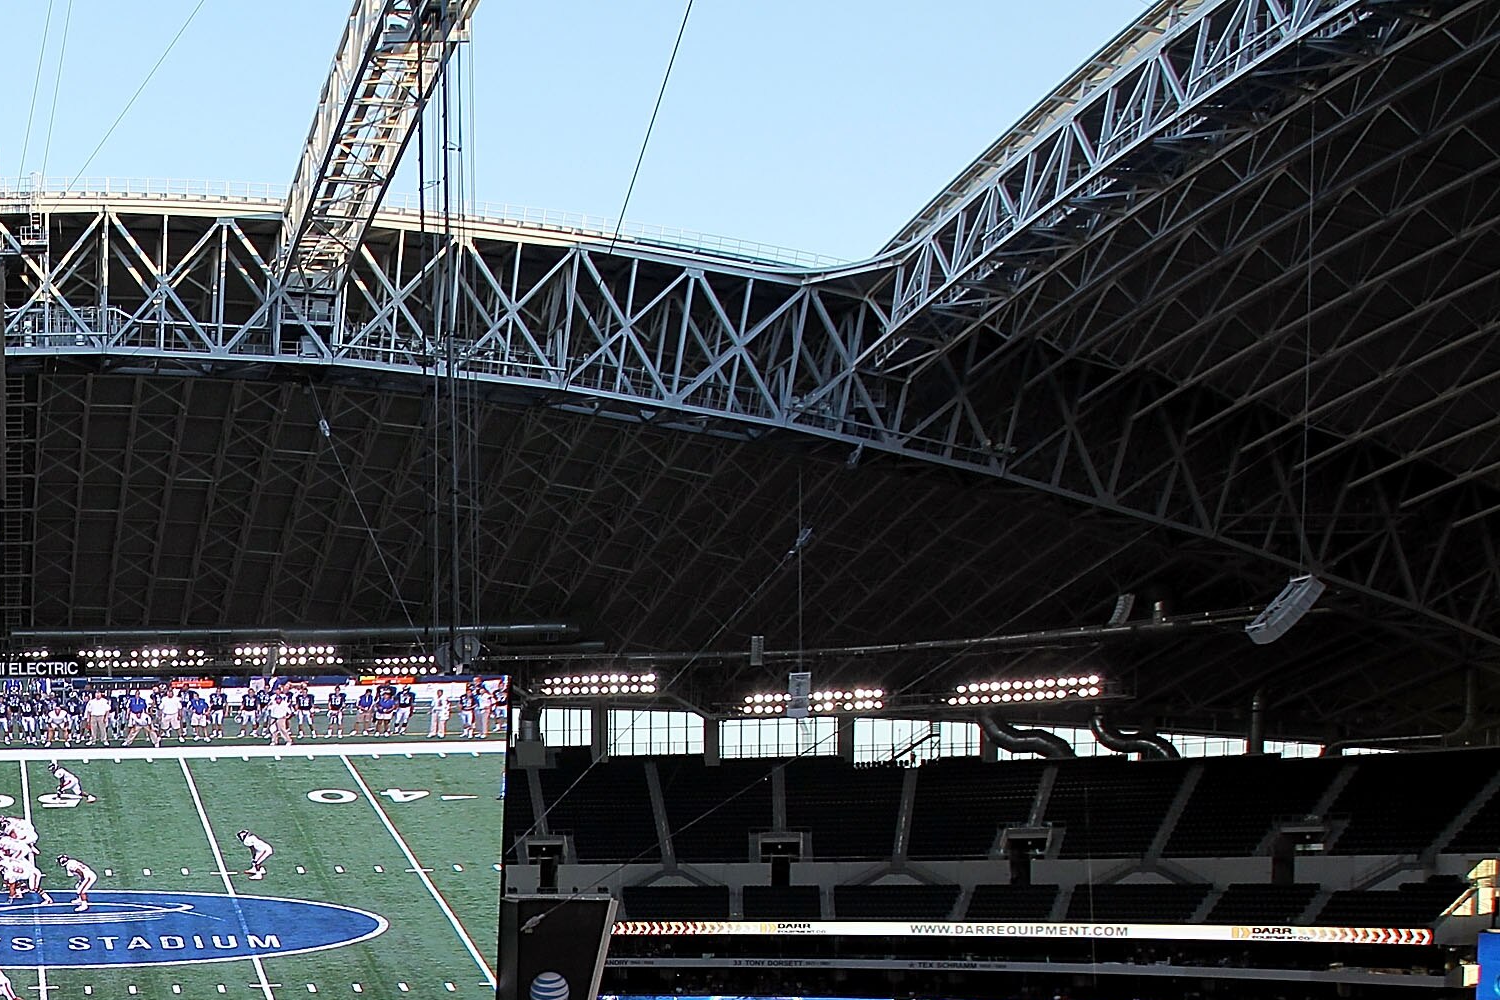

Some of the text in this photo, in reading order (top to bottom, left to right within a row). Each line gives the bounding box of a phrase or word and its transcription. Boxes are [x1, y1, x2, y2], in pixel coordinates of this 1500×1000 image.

[8, 661, 78, 675] ELECTRIC
[910, 924, 1129, 937] WWW.DARREQUIPMENT.COM
[1252, 927, 1292, 935] DARR
[67, 934, 282, 951] STADIUM
